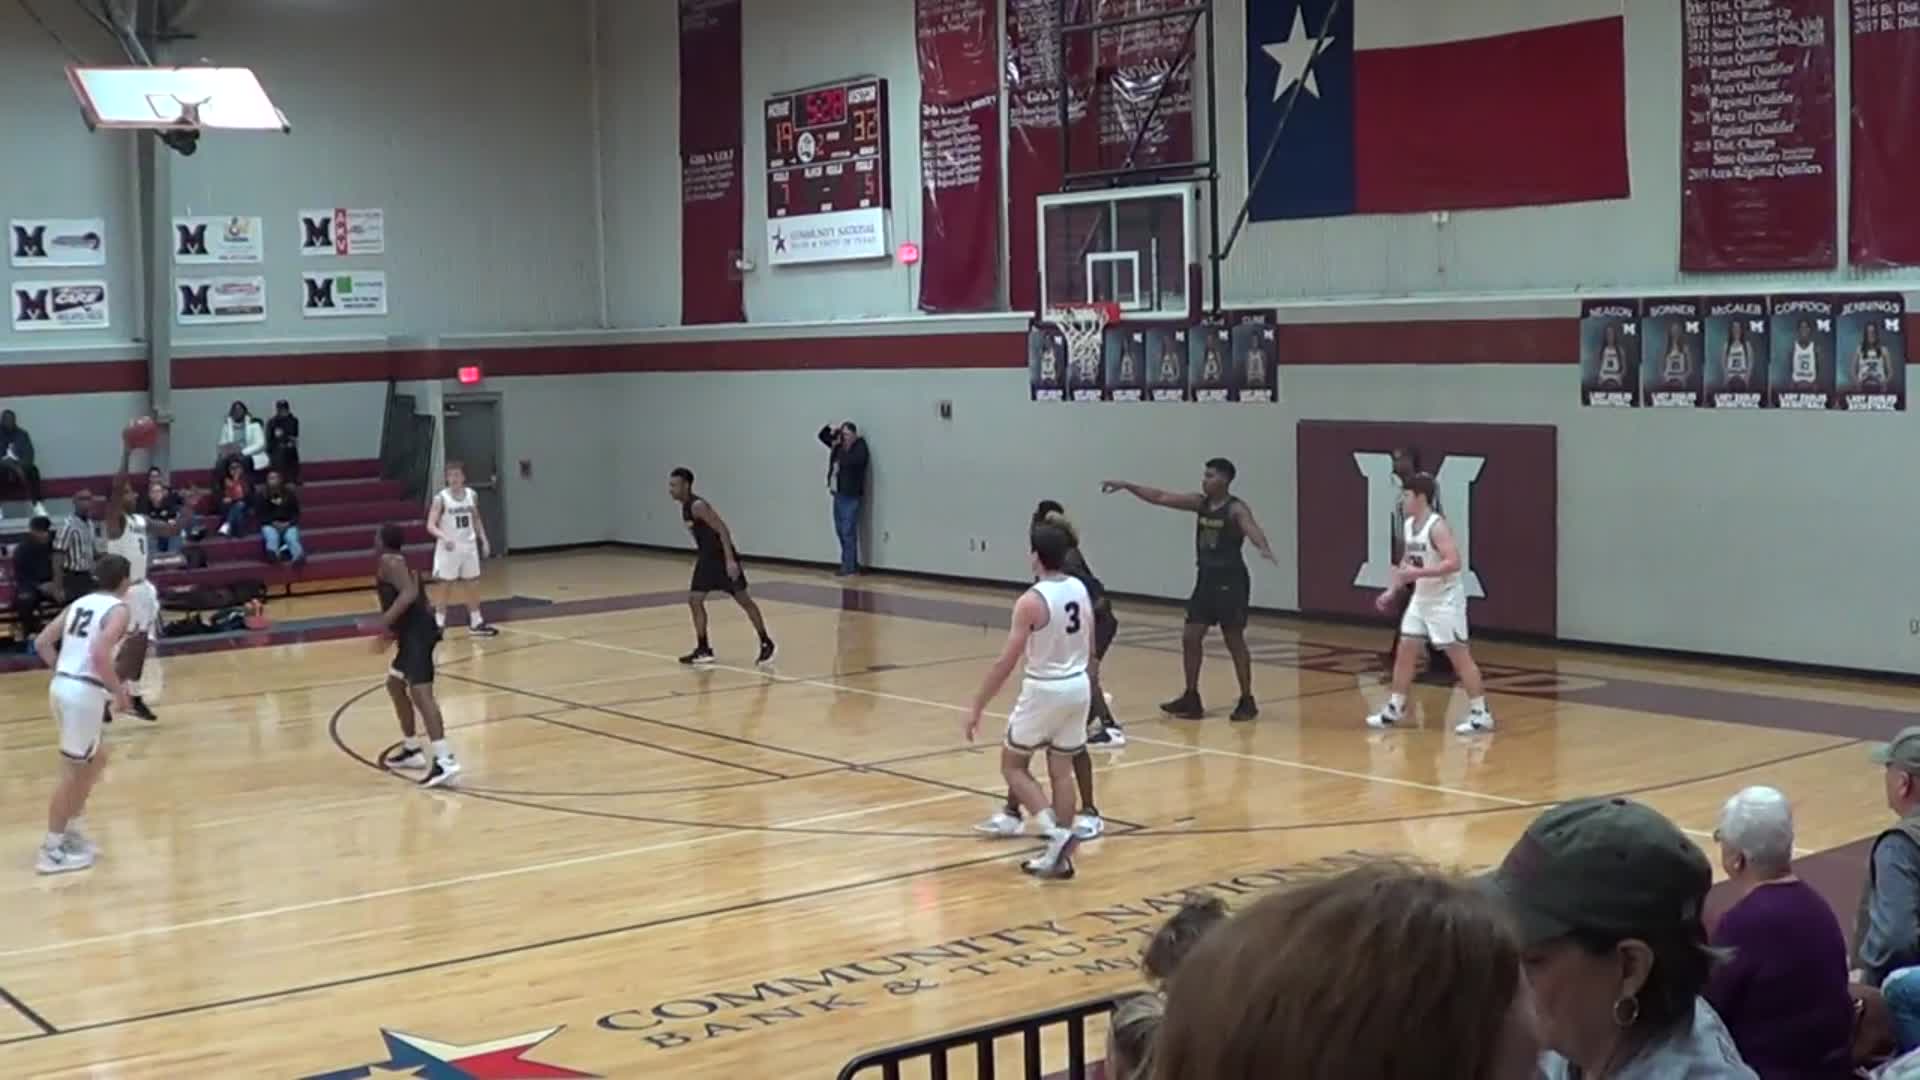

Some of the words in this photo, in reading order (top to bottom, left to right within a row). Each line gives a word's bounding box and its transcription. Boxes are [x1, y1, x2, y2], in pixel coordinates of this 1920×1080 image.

[776, 121, 793, 153] 19
[854, 107, 878, 141] 32
[13, 225, 47, 257] M
[176, 224, 208, 254] M
[303, 218, 332, 247] M
[16, 289, 49, 320] M
[179, 284, 210, 315] M
[305, 278, 334, 307] M
[1841, 301, 1900, 316] JENNINGS
[67, 607, 94, 638] 12
[1064, 601, 1081, 634] 3
[597, 921, 1074, 1030] COMMUNITY
[643, 993, 868, 1049] BANK
[884, 979, 939, 996] &
